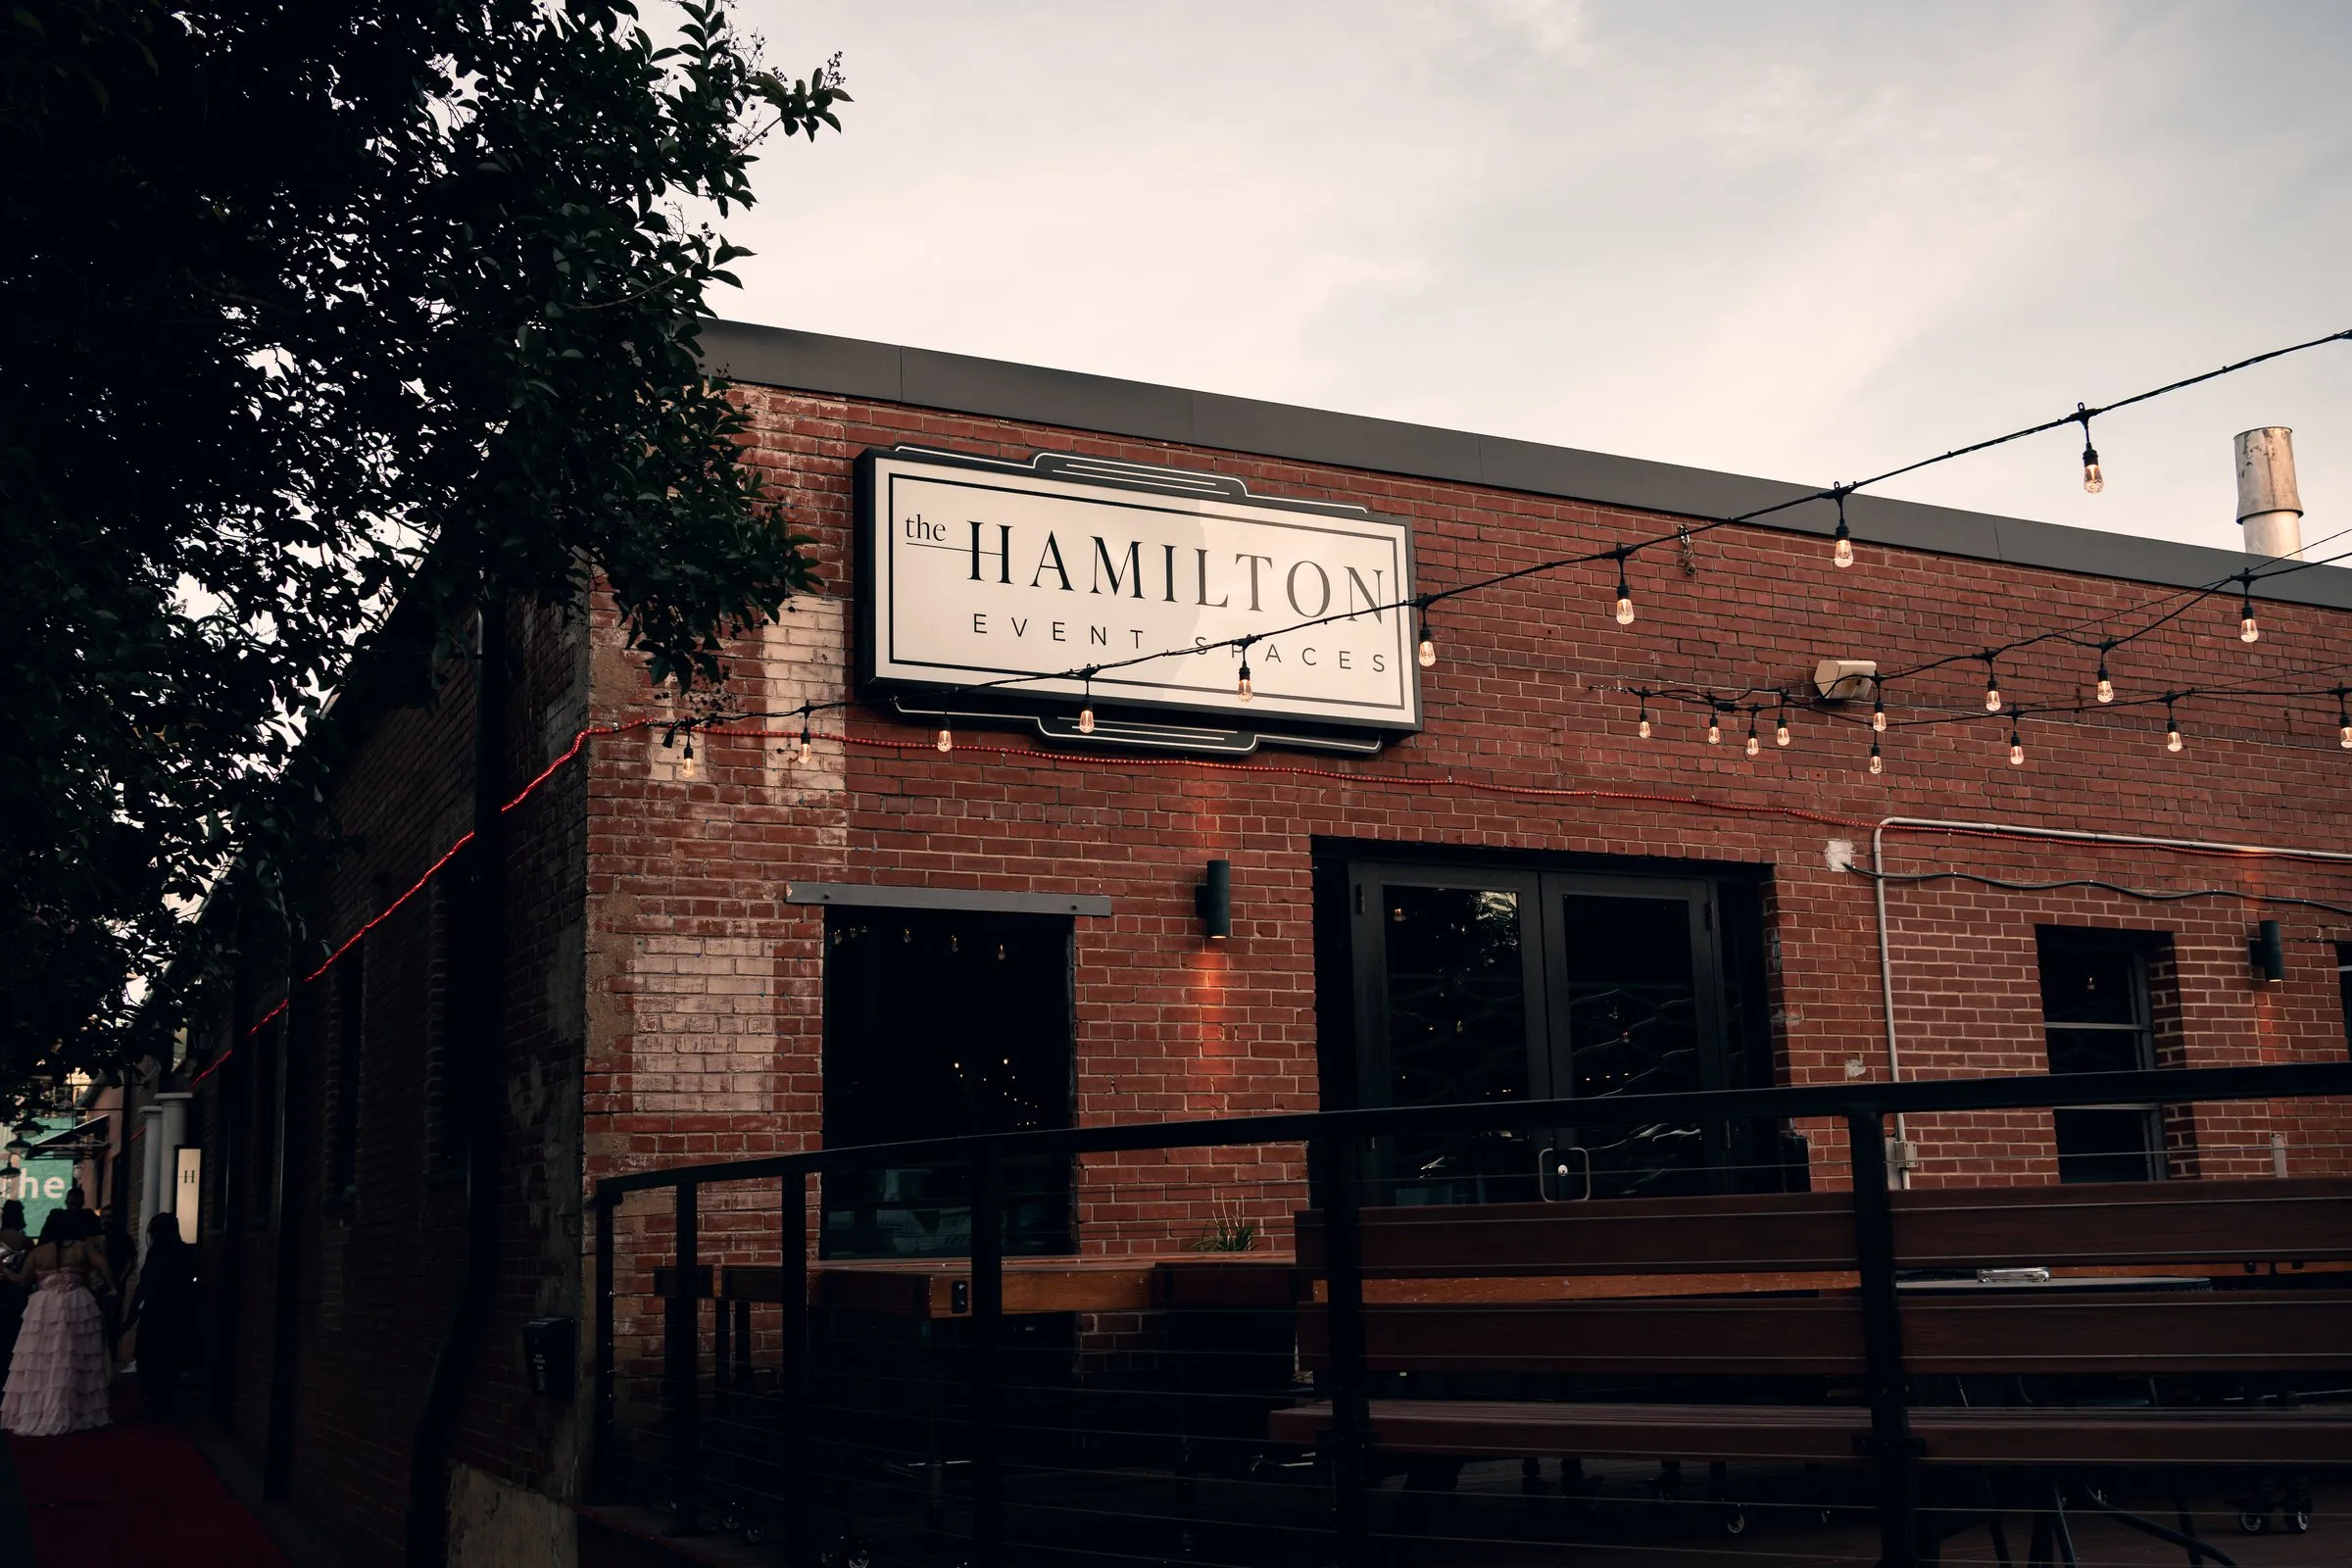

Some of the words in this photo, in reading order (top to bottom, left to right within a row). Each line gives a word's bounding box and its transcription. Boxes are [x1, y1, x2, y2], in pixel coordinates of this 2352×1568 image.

[905, 514, 946, 542] the
[966, 519, 1385, 625] HAMILTON
[973, 612, 1145, 650] EVENT
[1195, 636, 1386, 673] SPACES
